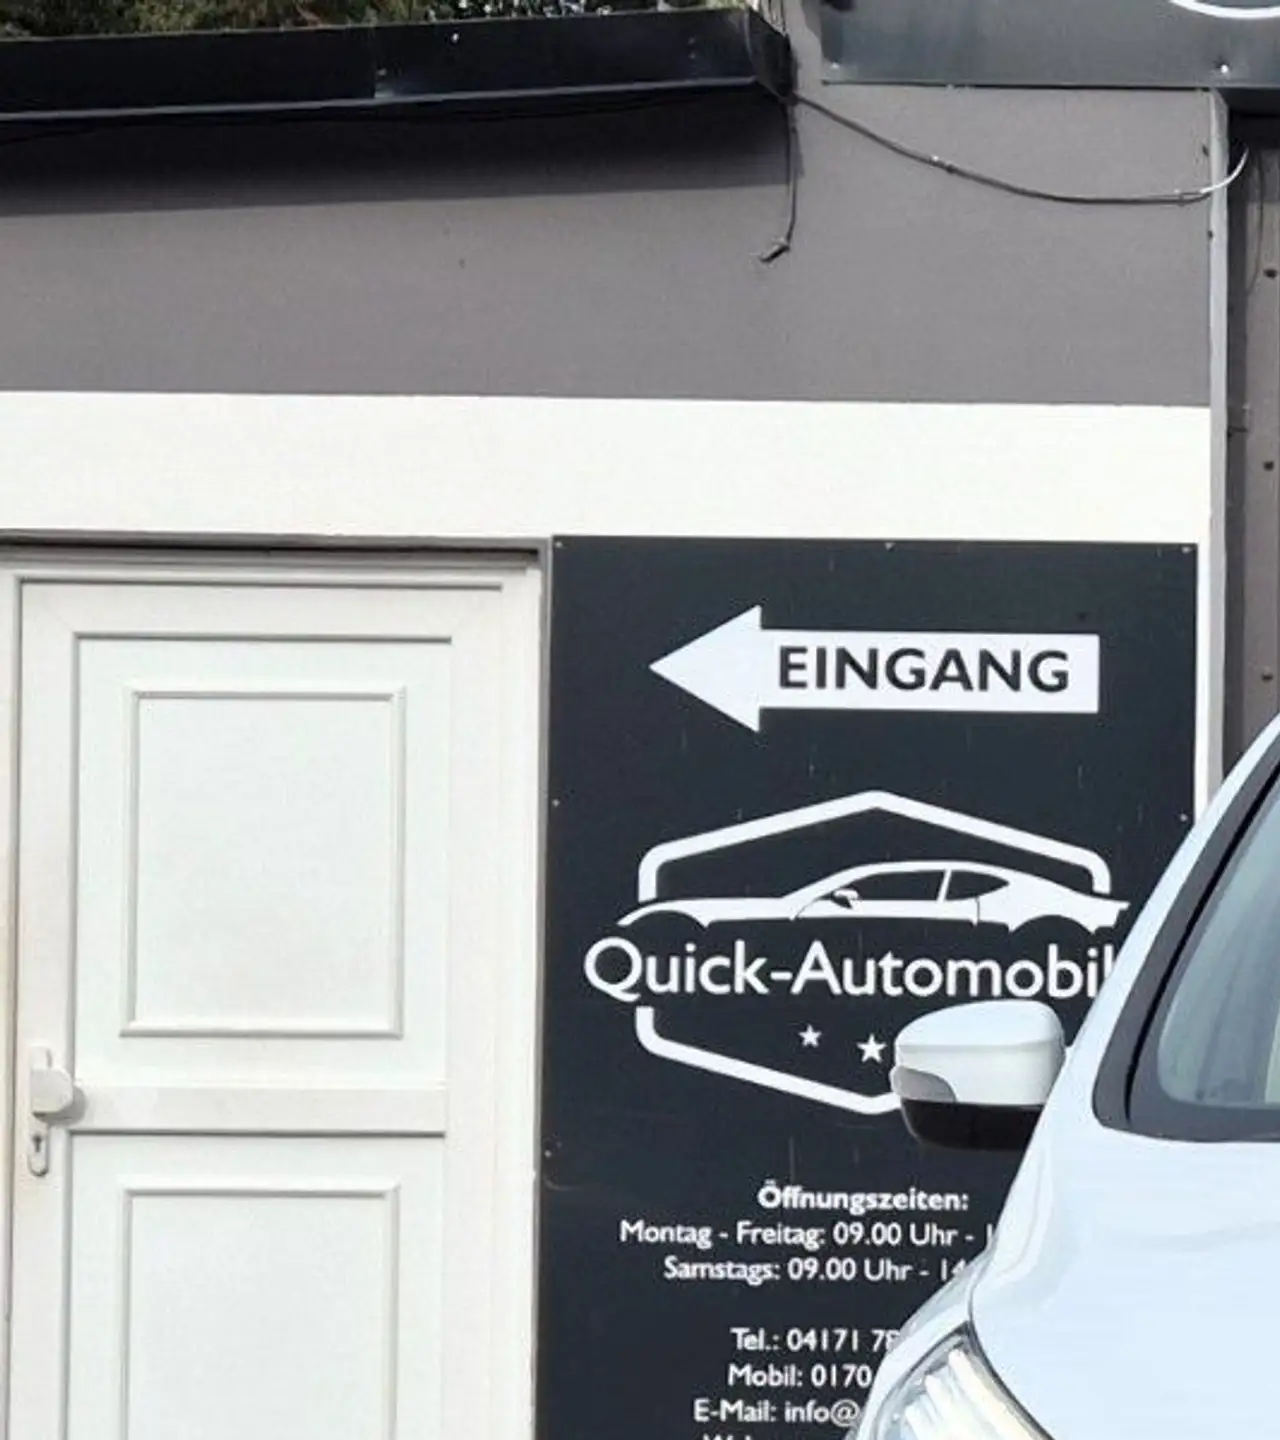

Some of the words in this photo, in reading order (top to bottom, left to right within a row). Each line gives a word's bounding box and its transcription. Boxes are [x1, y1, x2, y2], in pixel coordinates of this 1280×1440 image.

[777, 646, 1070, 694] EINGANG
[757, 1180, 969, 1216] Öffnungszeiten:
[619, 1219, 713, 1250] Montag
[736, 1220, 826, 1251] Freitag:
[832, 1221, 902, 1246] 09.00
[909, 1223, 958, 1246] Uhr
[663, 1254, 781, 1286] Samstags:
[787, 1257, 857, 1281] 09.00
[864, 1258, 913, 1281] Uhr
[730, 1327, 780, 1351] Tel.:
[786, 1329, 859, 1352] 04171
[727, 1363, 803, 1388] Mobil:
[811, 1364, 872, 1388] 0170
[693, 1398, 777, 1422] E-Mail:
